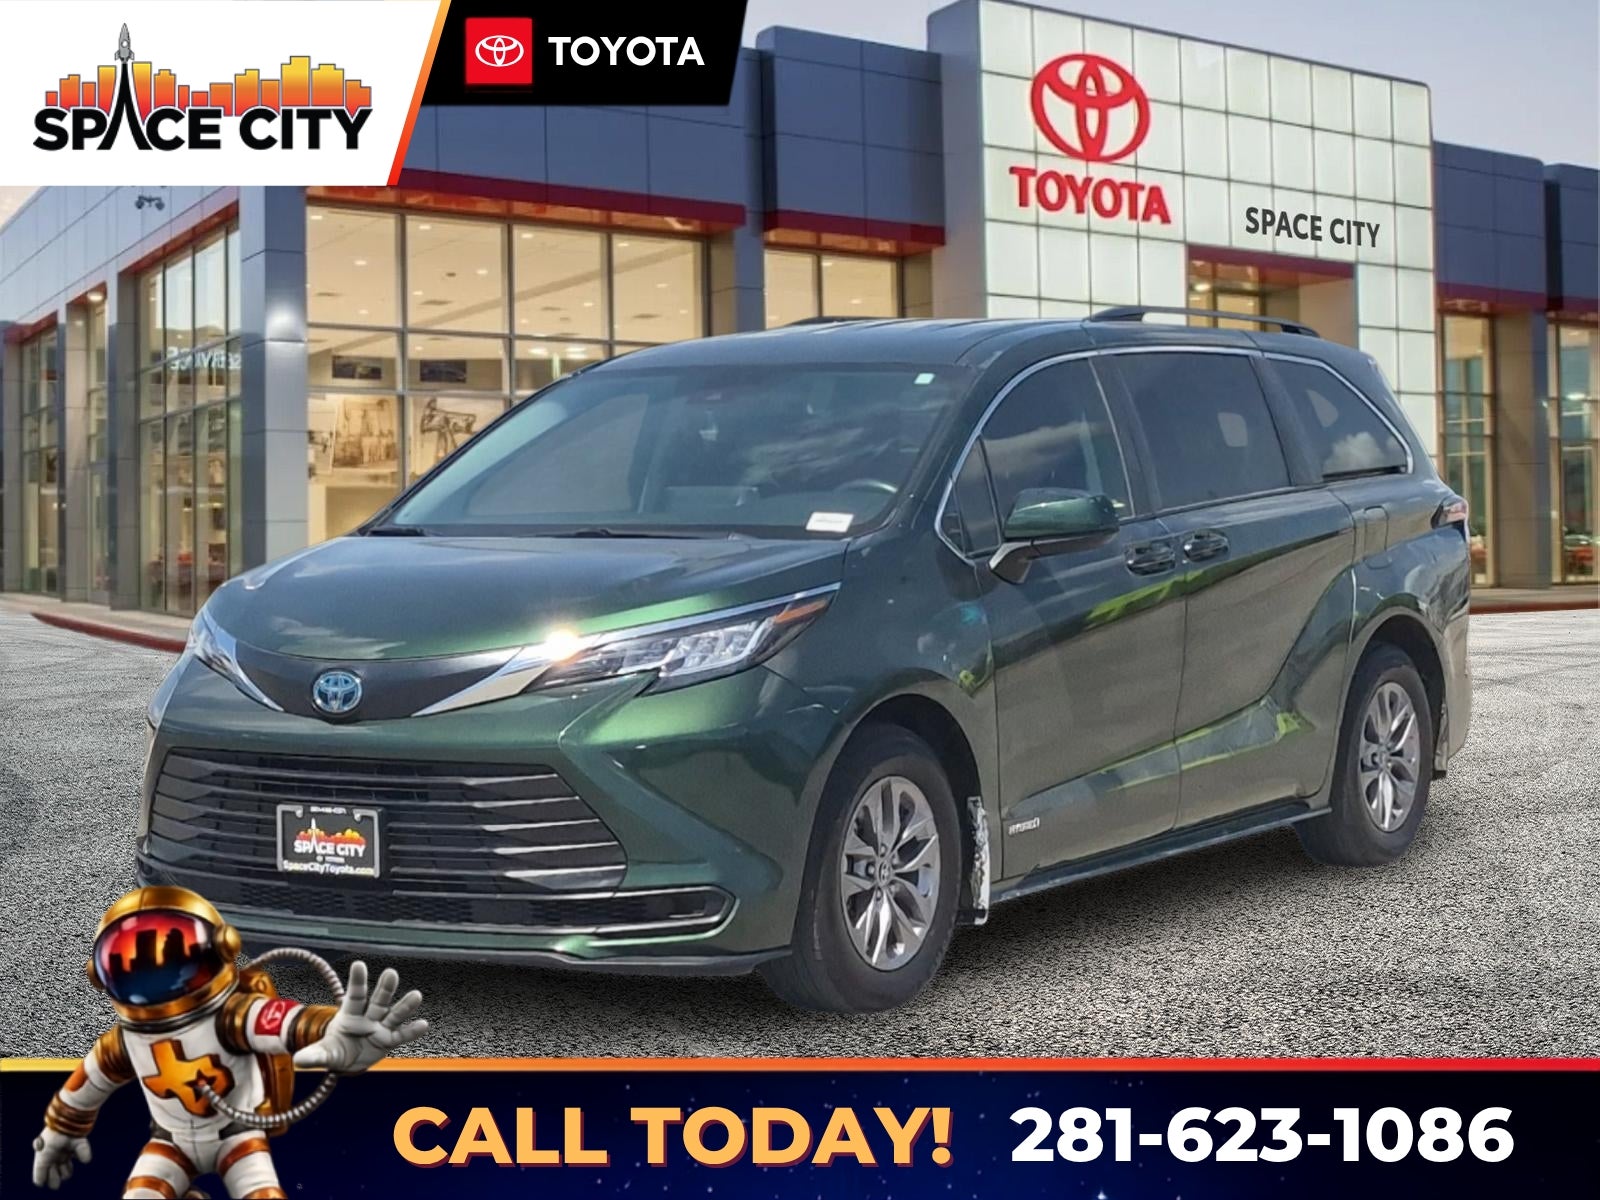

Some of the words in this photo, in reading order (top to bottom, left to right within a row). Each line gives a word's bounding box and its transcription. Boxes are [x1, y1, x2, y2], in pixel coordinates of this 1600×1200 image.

[1009, 165, 1171, 225] TOYOTA
[1244, 206, 1323, 242] SPACE
[1328, 217, 1381, 248] CITY
[293, 839, 336, 855] SPACE
[336, 843, 367, 857] CITY
